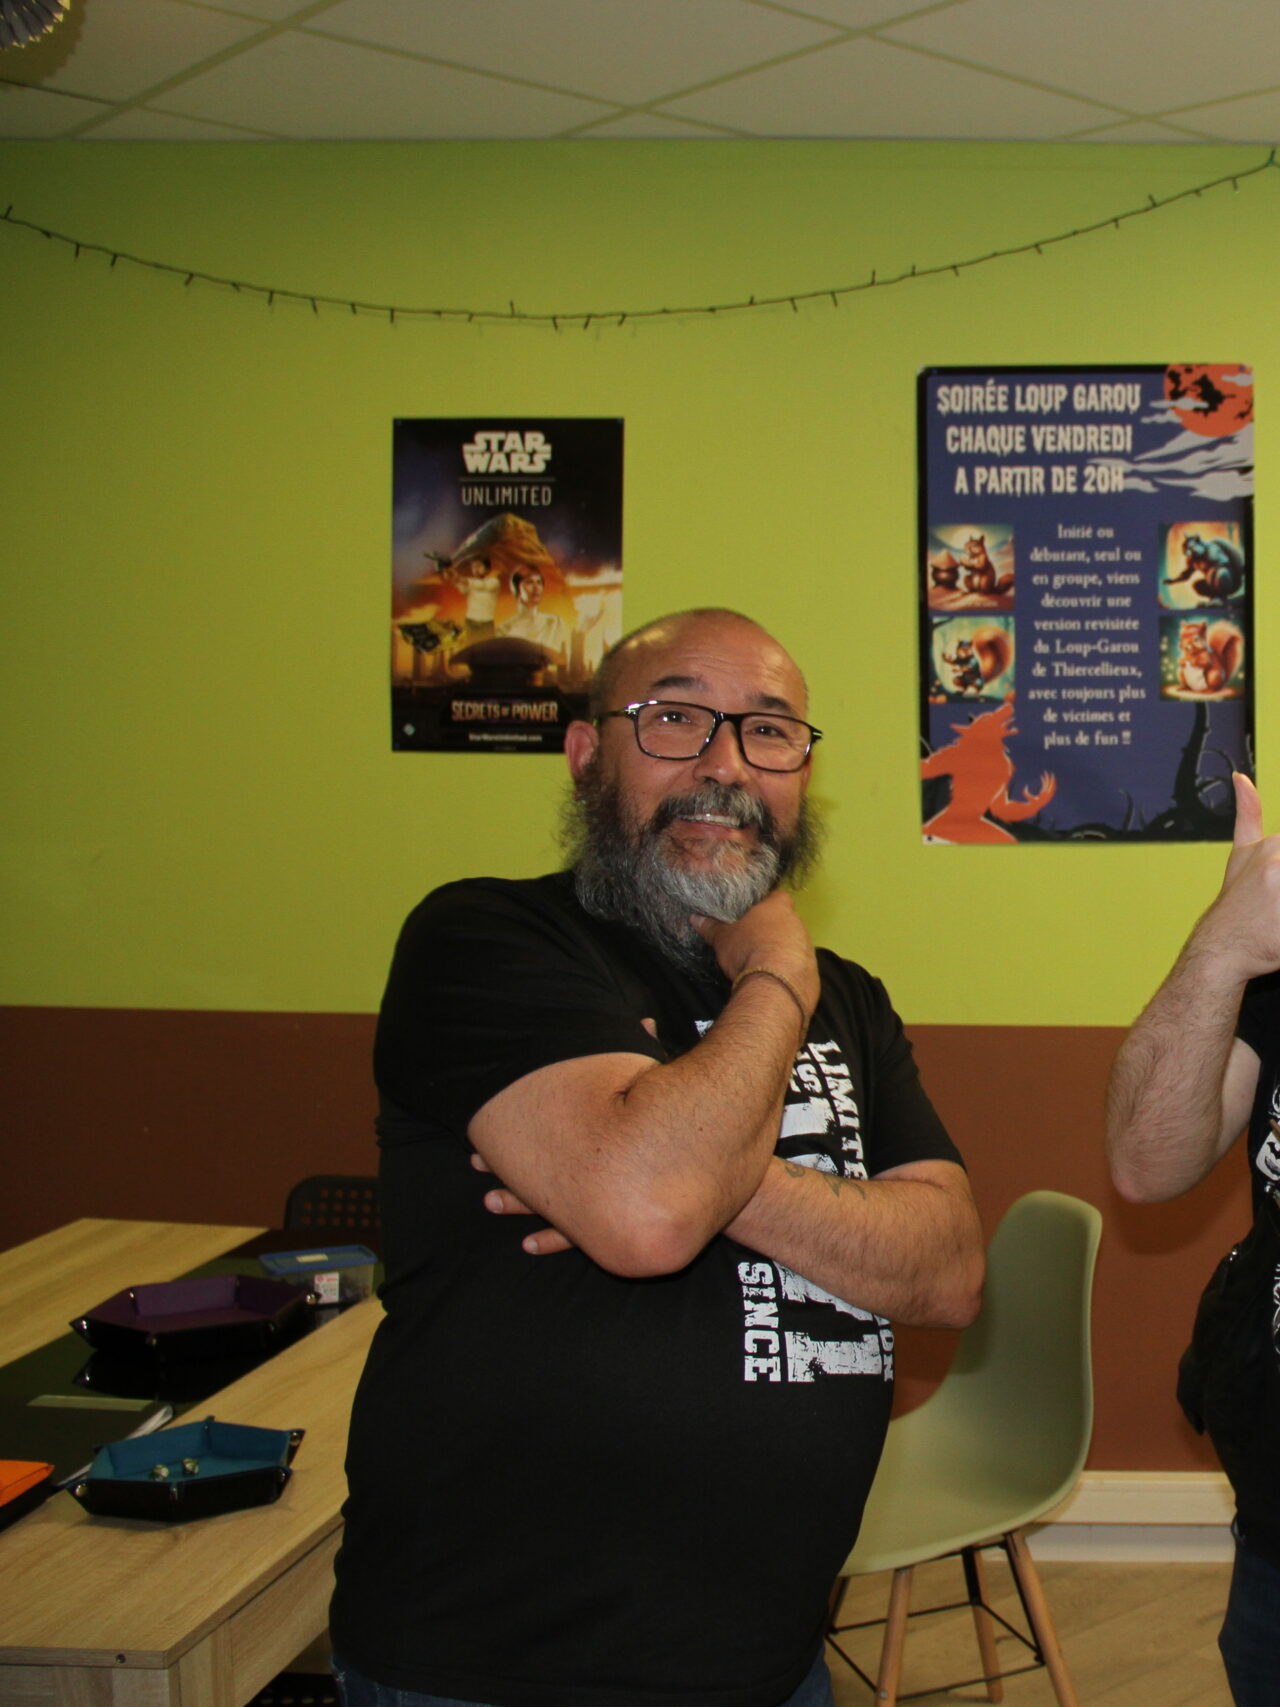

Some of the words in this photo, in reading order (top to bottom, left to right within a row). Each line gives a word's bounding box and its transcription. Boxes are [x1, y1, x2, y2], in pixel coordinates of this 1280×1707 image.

[937, 378, 1009, 415] SOIRÉE
[1015, 384, 1068, 416] LOUP
[1072, 384, 1141, 415] GAROU
[462, 431, 552, 453] STAR
[946, 425, 1026, 457] CHAQUE
[1031, 424, 1133, 455] VENDREDI
[462, 453, 552, 474] WARS
[955, 467, 969, 495] A
[974, 466, 1045, 498] PARTIR
[1052, 466, 1076, 494] DE
[1083, 465, 1125, 494] 20H
[461, 487, 552, 505] UNLIMITED
[1057, 524, 1093, 539] Initié
[1097, 527, 1114, 538] ou
[1030, 547, 1090, 563] débutant,
[1094, 547, 1120, 561] seul
[1124, 550, 1142, 561] ou
[1032, 574, 1048, 585] en
[1052, 574, 1103, 589] groupe,
[1106, 572, 1140, 585] viens
[1040, 593, 1102, 608] découvrir
[1106, 596, 1132, 607] une
[1034, 617, 1081, 631] version
[1085, 616, 1140, 631] revisitée
[1033, 640, 1049, 654] du
[1055, 639, 1140, 658] Loup-Garou
[1032, 663, 1047, 677] de
[1051, 661, 1142, 678] Thiercellieux,
[1028, 687, 1057, 700] avec
[1061, 686, 1116, 702] toujours
[1118, 685, 1146, 702] plus
[451, 700, 500, 720] SECRETS
[512, 700, 558, 722] POWER
[1043, 708, 1058, 722] de
[1062, 708, 1115, 722] victimes
[1118, 710, 1131, 722] et
[1044, 733, 1071, 750] plus
[1075, 731, 1090, 745] de
[1094, 730, 1119, 745] fun
[737, 1261, 782, 1383] SINCE
